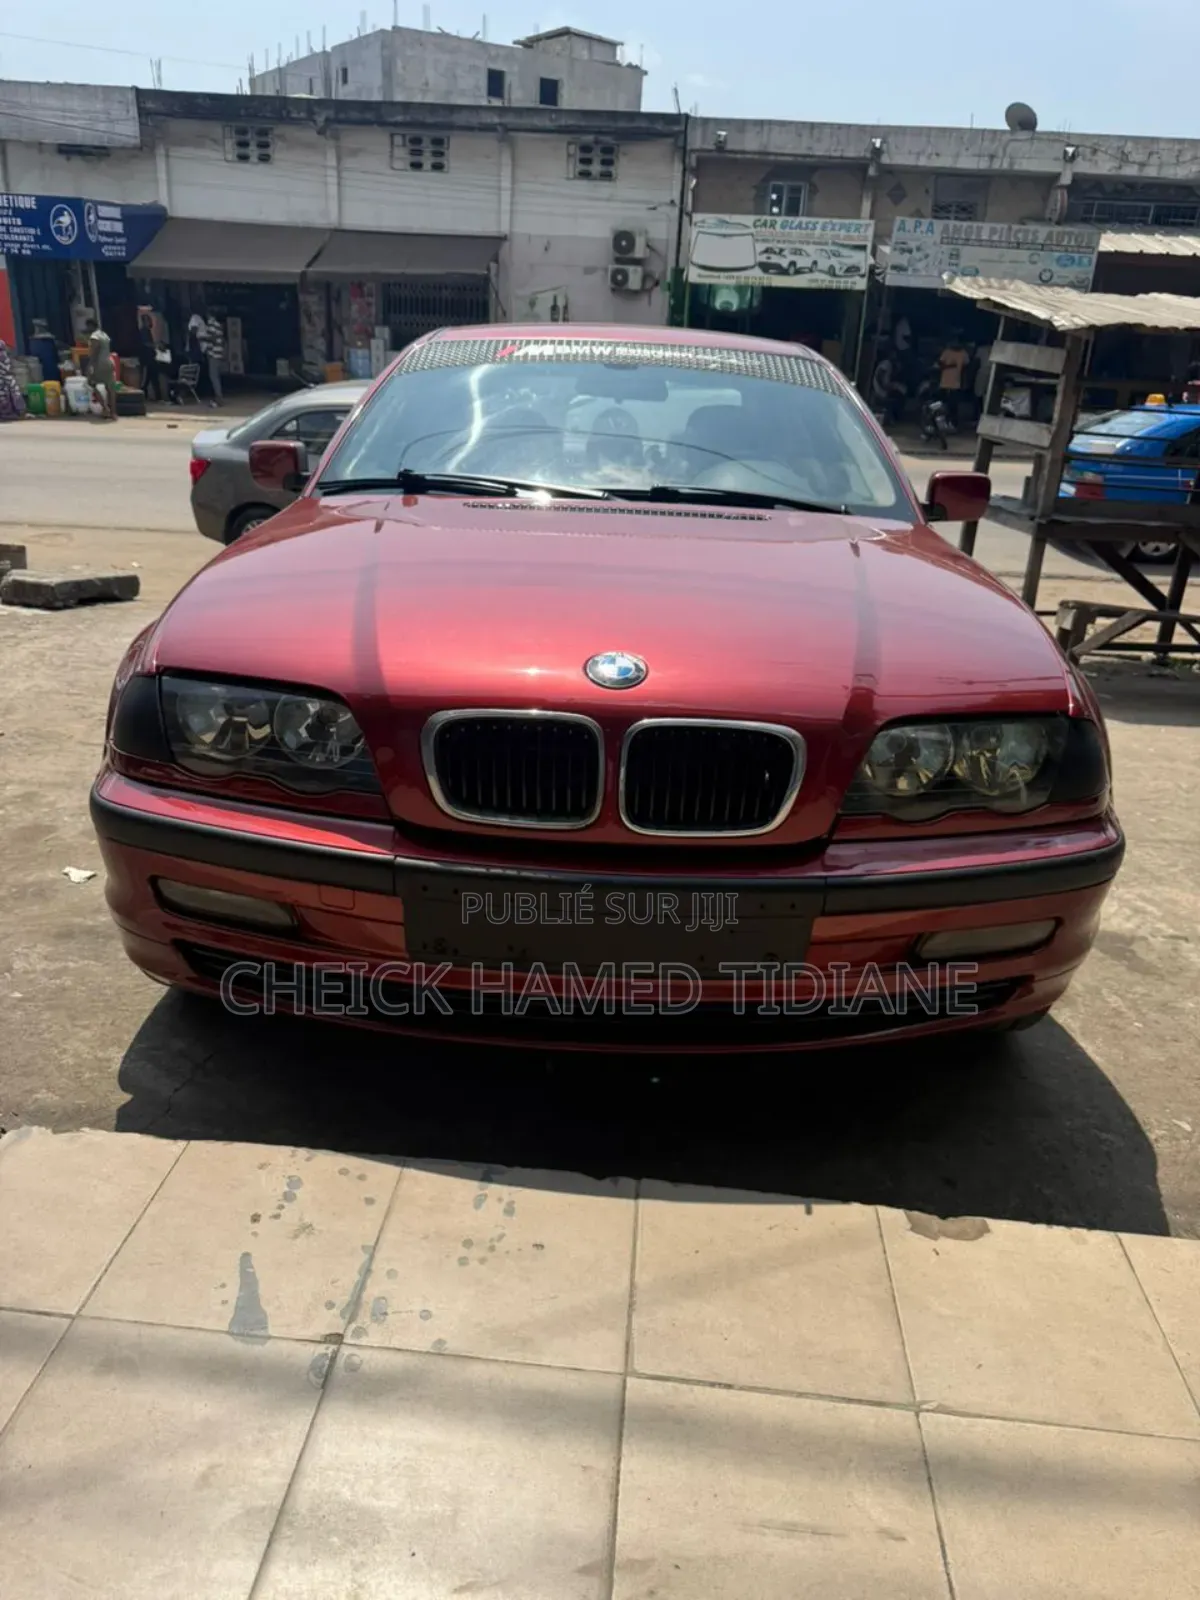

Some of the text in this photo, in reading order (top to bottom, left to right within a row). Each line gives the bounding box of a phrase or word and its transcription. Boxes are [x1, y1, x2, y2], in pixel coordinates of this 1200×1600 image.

[753, 219, 873, 234] CAR GLASS EXPERT
[896, 218, 935, 236] A.P.A
